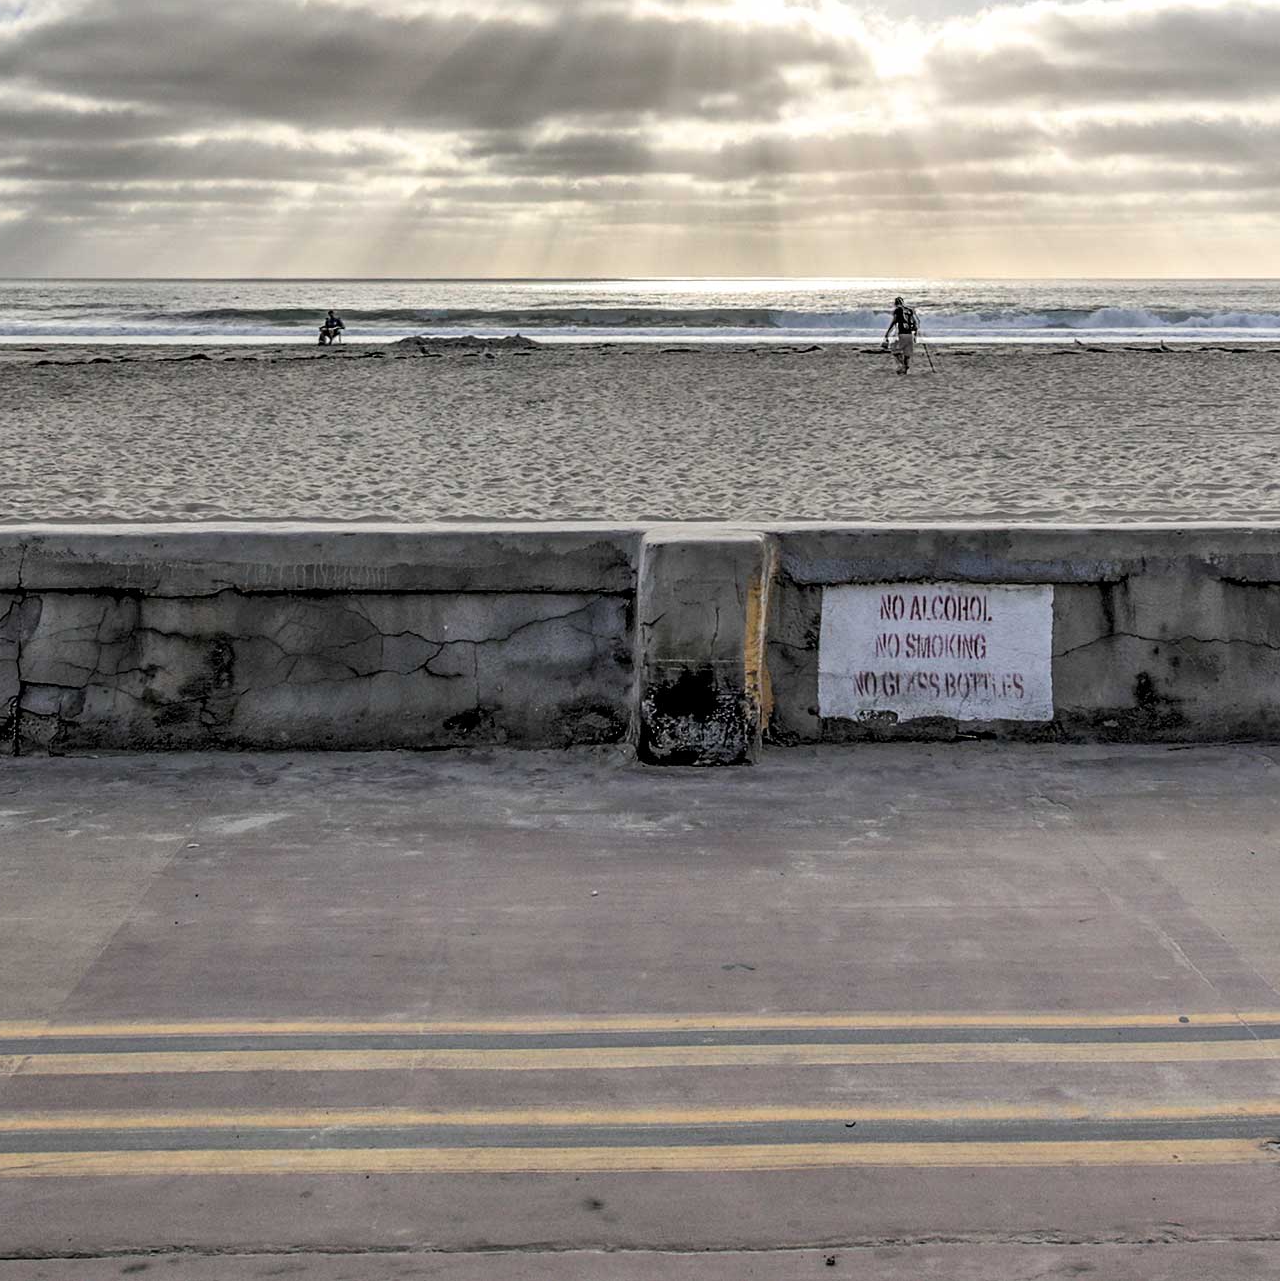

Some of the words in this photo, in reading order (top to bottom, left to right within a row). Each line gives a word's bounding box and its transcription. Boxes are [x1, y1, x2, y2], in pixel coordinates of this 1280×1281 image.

[880, 594, 904, 621] NO
[910, 595, 992, 621] ALCOHOL
[876, 633, 899, 658] NO
[905, 634, 986, 659] SMOKING
[853, 671, 877, 697] NO
[882, 671, 940, 698] GLASS
[945, 672, 1024, 699] BOTTLES
